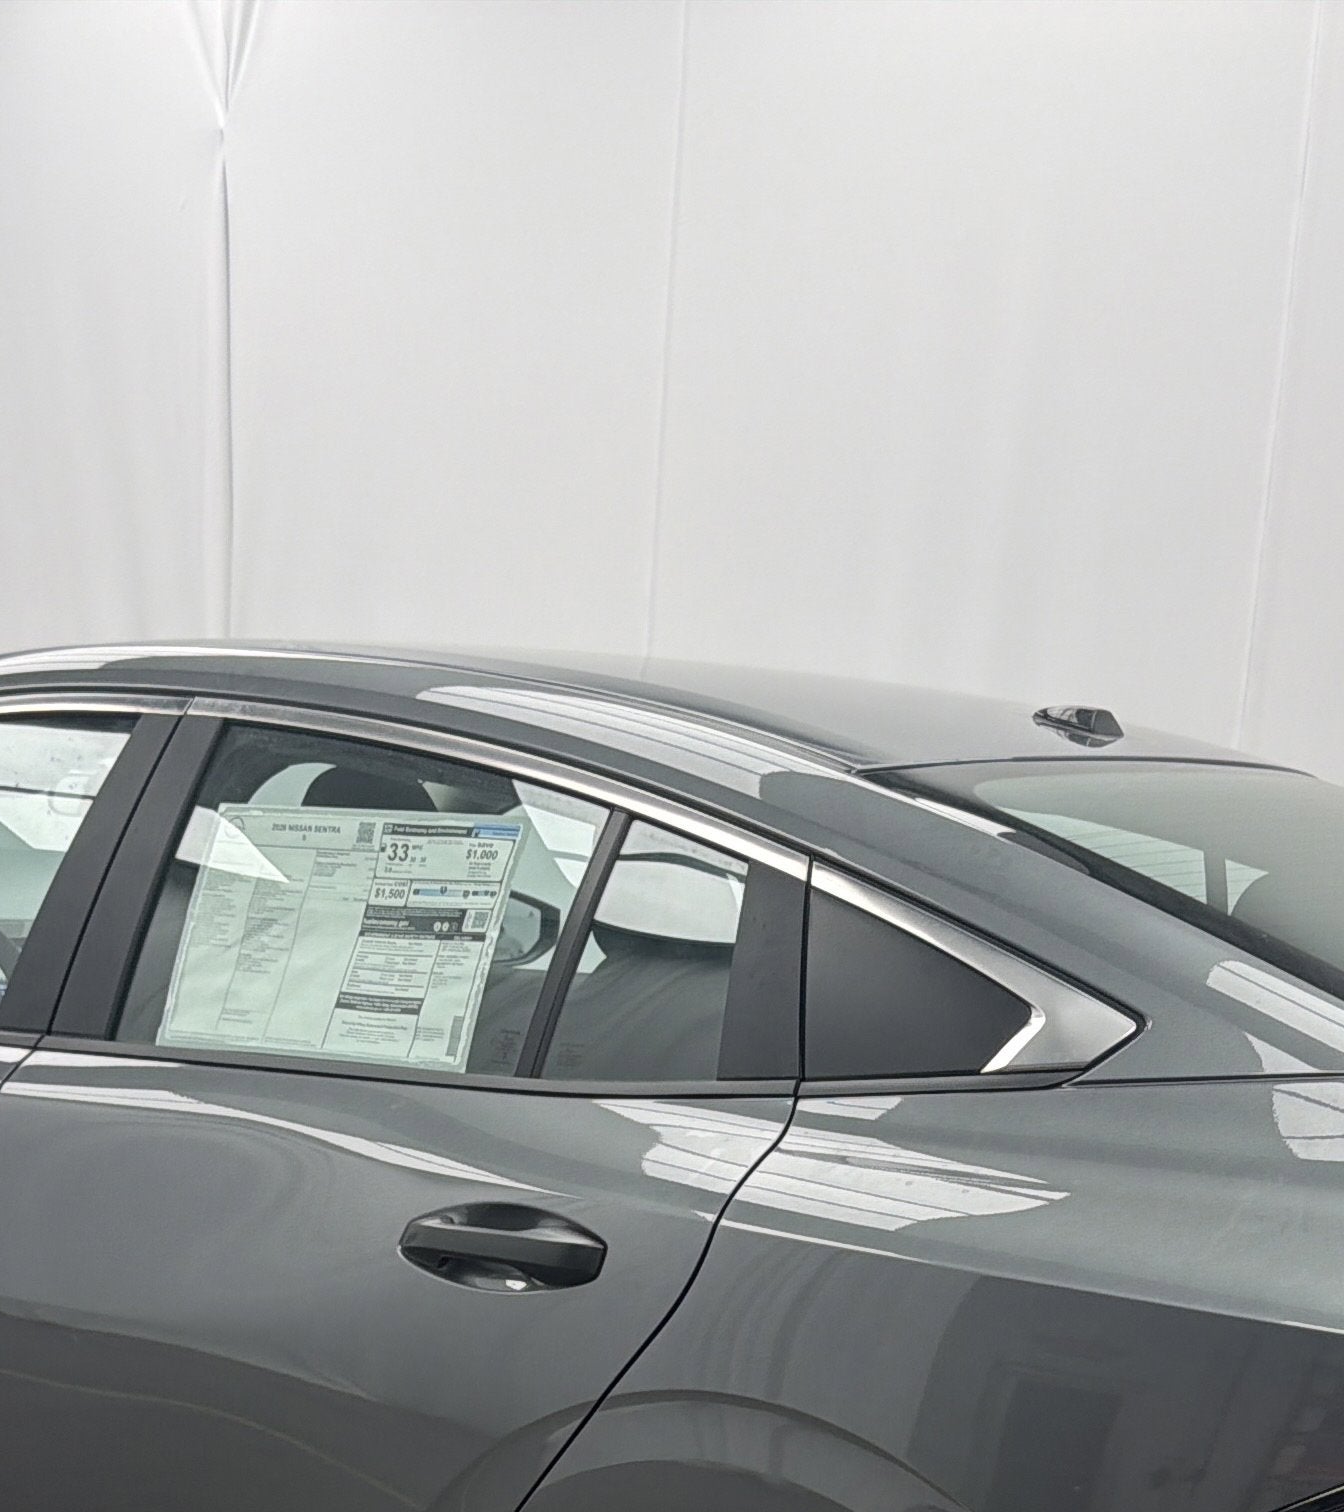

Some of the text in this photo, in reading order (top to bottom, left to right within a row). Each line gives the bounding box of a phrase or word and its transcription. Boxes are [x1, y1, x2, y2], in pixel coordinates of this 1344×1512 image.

[387, 842, 410, 862] 33
[465, 848, 499, 860] $1,000
[374, 887, 406, 900] $1,500
